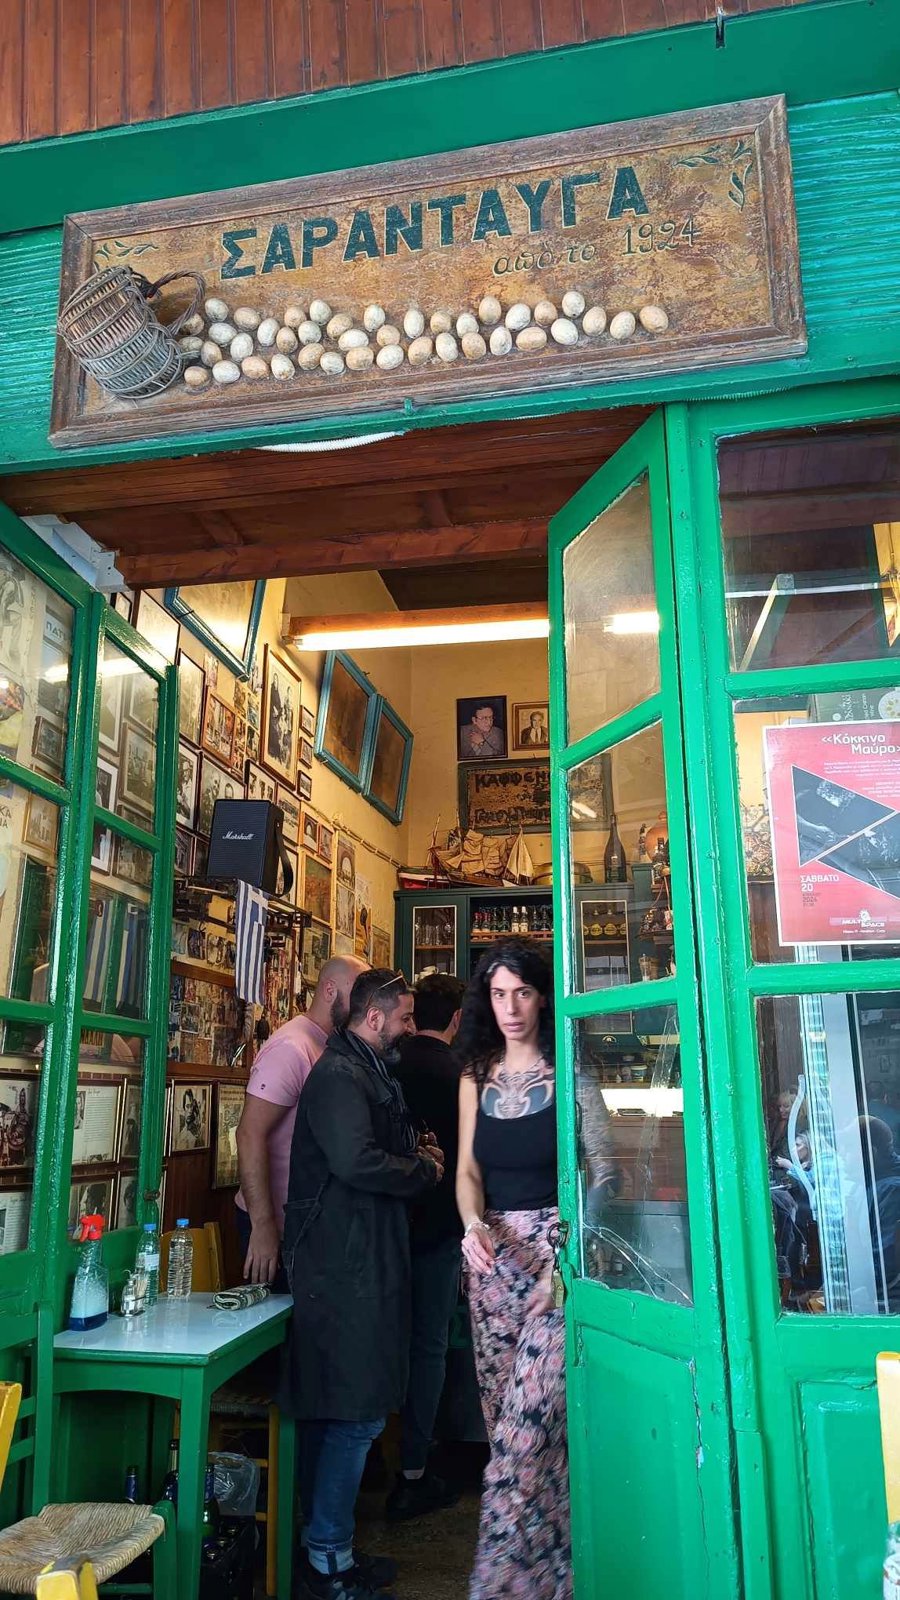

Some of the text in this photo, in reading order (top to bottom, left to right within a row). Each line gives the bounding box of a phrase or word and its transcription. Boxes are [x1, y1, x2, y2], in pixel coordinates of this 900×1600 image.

[219, 165, 650, 282] ΣΑΡΑΝΤΑΥΓΑ
[566, 243, 596, 264] το
[621, 212, 701, 257] 1924
[222, 830, 255, 840] Marshall
[800, 874, 839, 883] ΣΑΒΒΑΤΟ
[801, 883, 814, 892] 20
